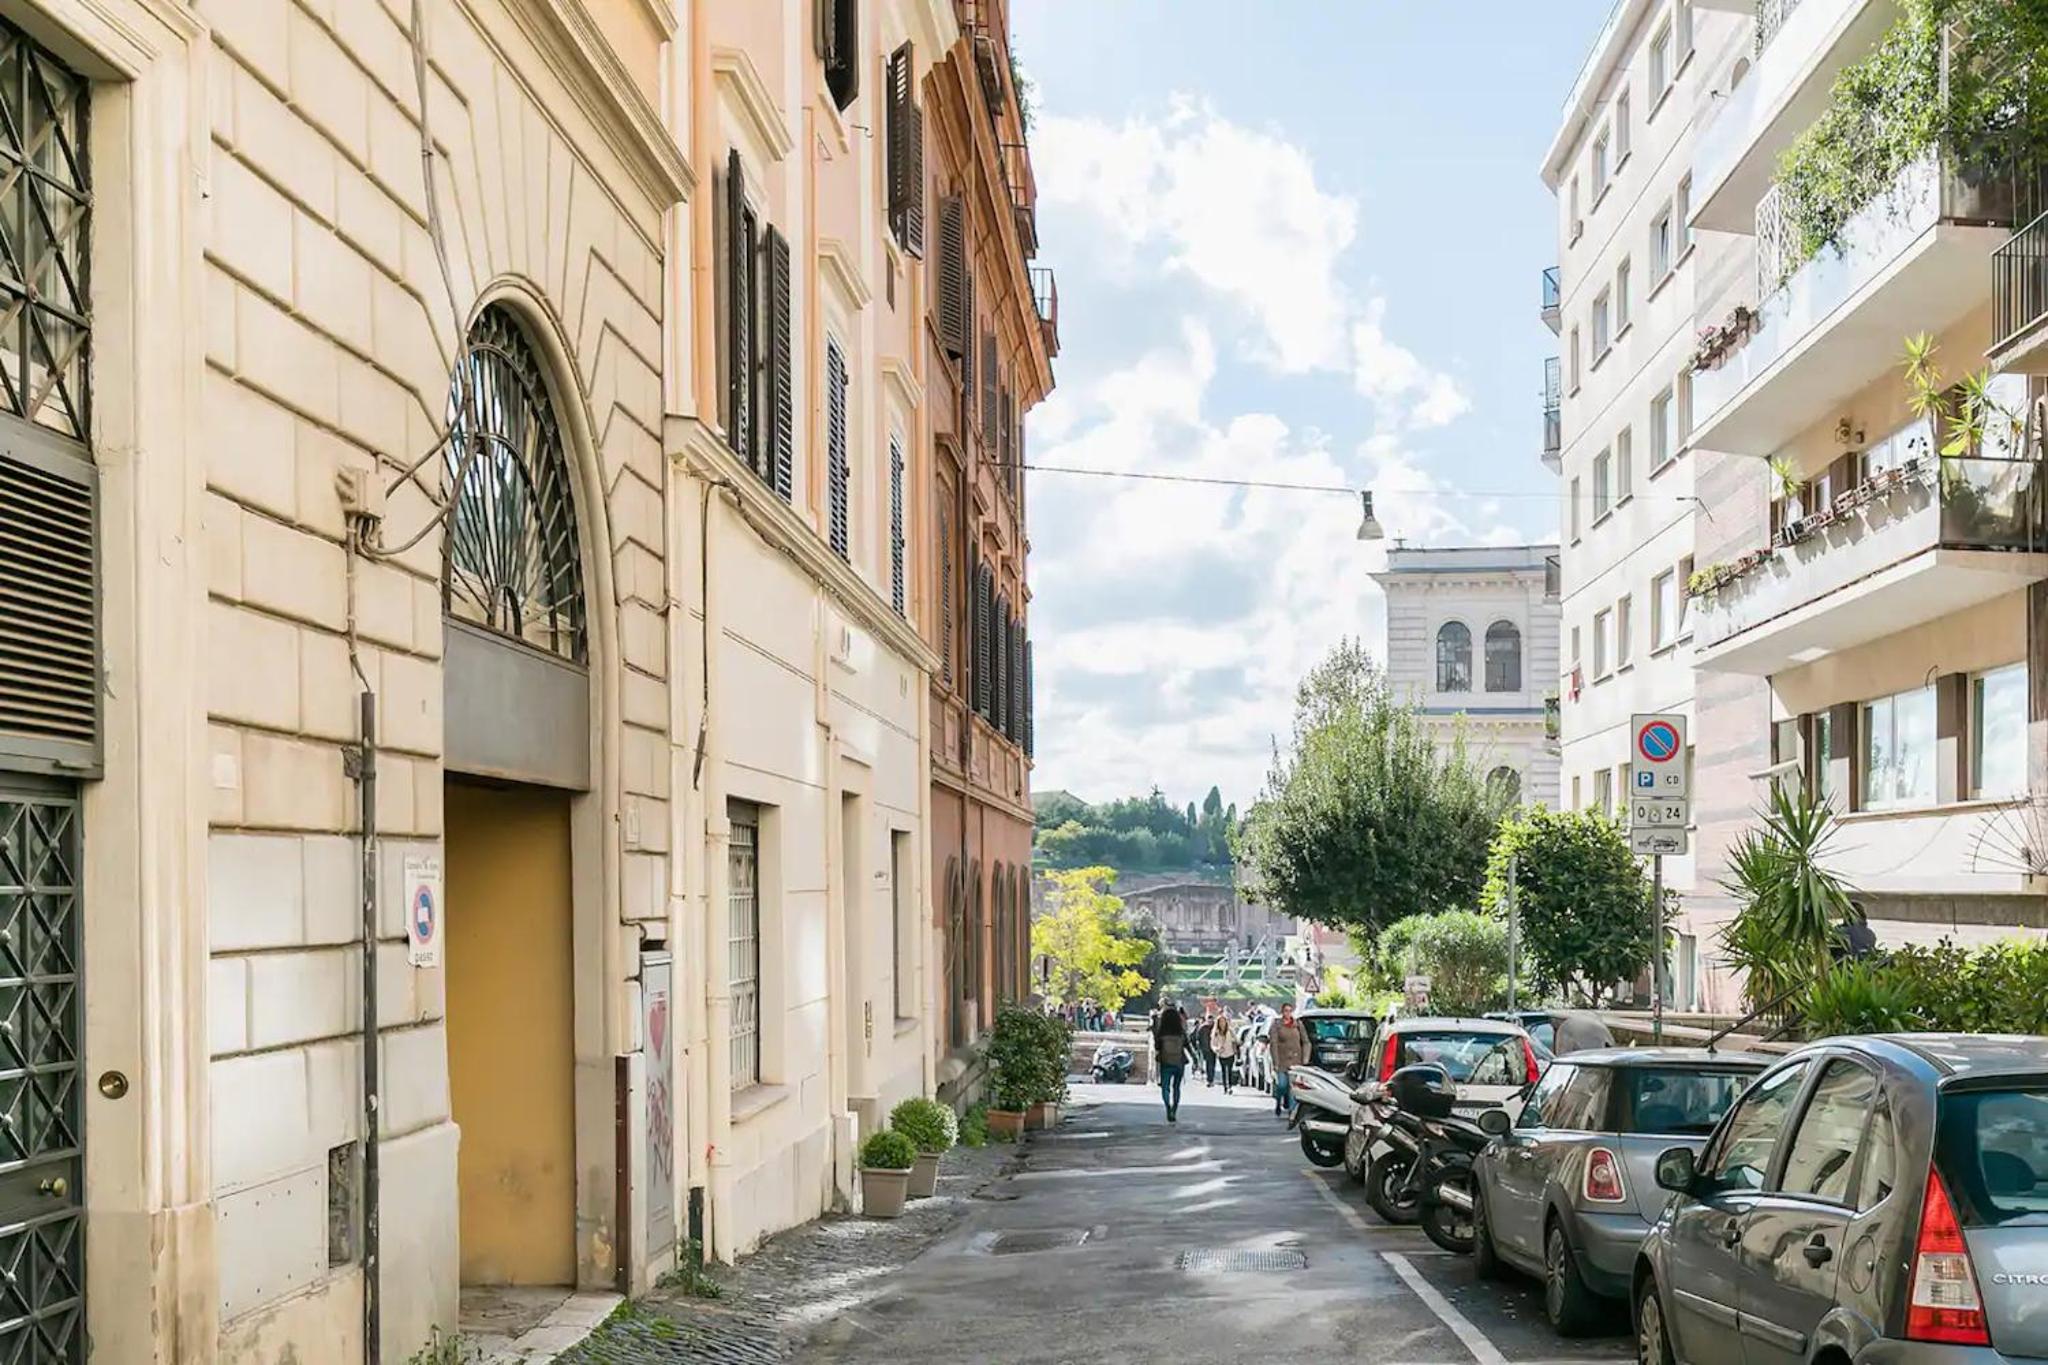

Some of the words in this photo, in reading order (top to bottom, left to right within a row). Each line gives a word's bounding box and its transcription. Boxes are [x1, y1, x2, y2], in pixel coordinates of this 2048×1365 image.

[1640, 772, 1652, 786] P
[1666, 775, 1679, 785] CD
[1666, 807, 1680, 819] 24
